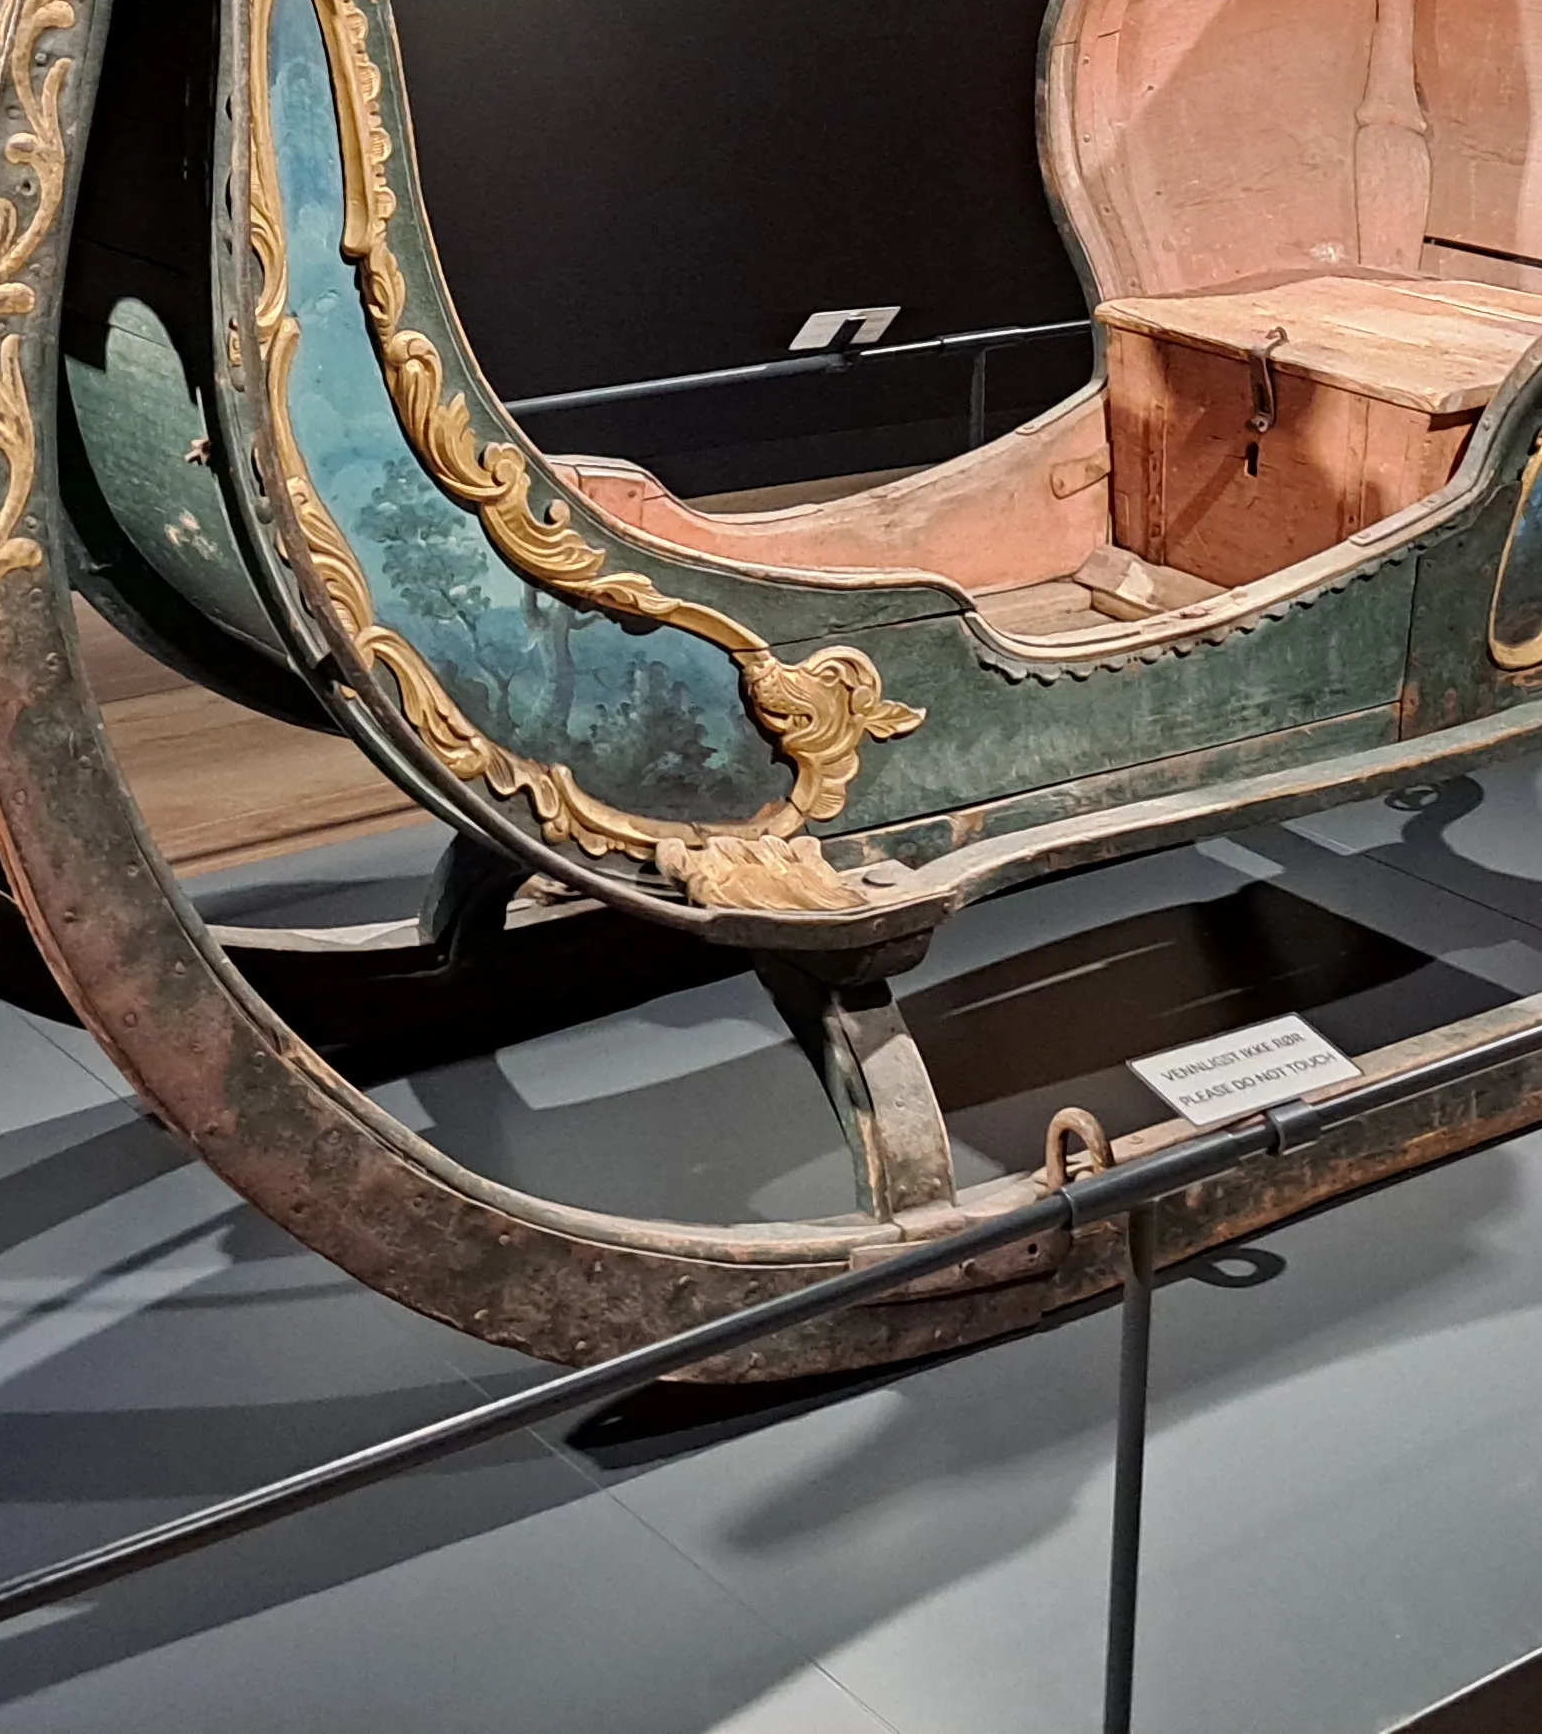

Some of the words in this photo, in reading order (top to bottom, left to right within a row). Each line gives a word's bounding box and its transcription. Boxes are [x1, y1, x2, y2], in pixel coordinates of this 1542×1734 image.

[1160, 1051, 1241, 1081] VENNLIGST
[1240, 1042, 1276, 1060] IKKE
[1271, 1032, 1306, 1050] RØR
[1178, 1083, 1234, 1107] PLEASE
[1231, 1076, 1257, 1091] DO
[1255, 1068, 1288, 1083] NOT
[1285, 1051, 1338, 1074] TOUCH
